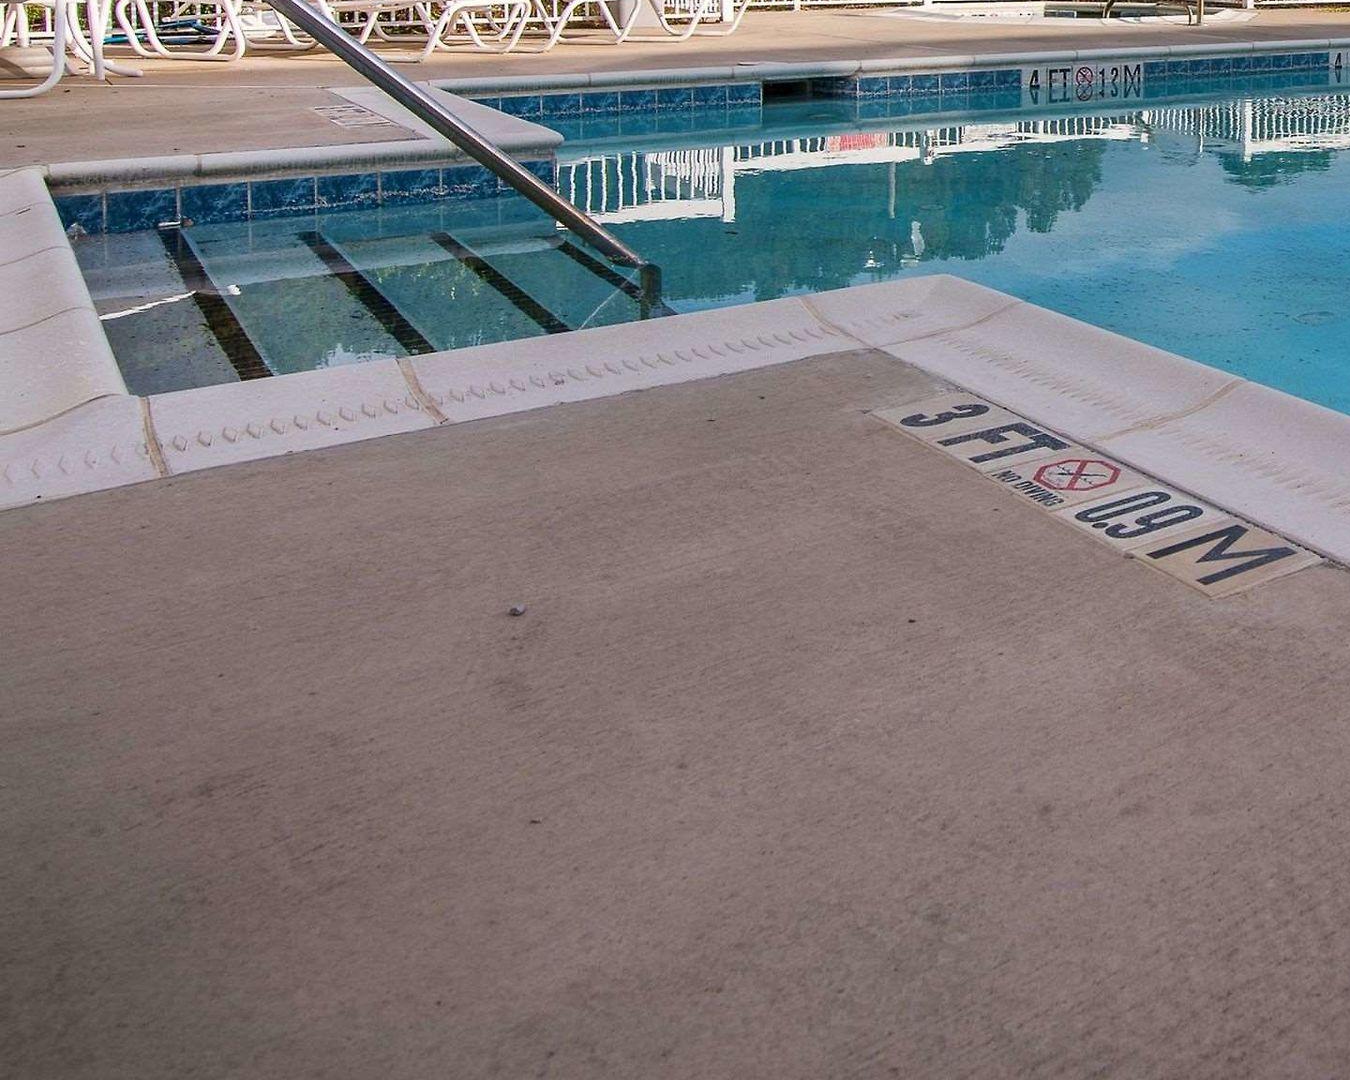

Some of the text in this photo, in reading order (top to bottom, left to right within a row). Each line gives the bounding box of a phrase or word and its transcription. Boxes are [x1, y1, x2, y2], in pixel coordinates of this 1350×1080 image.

[1335, 52, 1342, 69] 4
[1029, 70, 1040, 89] 4
[1048, 68, 1071, 90] FT
[1123, 64, 1140, 86] M
[899, 403, 990, 427] 3
[937, 421, 1069, 463] FT
[991, 469, 1064, 506] NO DIVING
[1145, 524, 1298, 585] M
